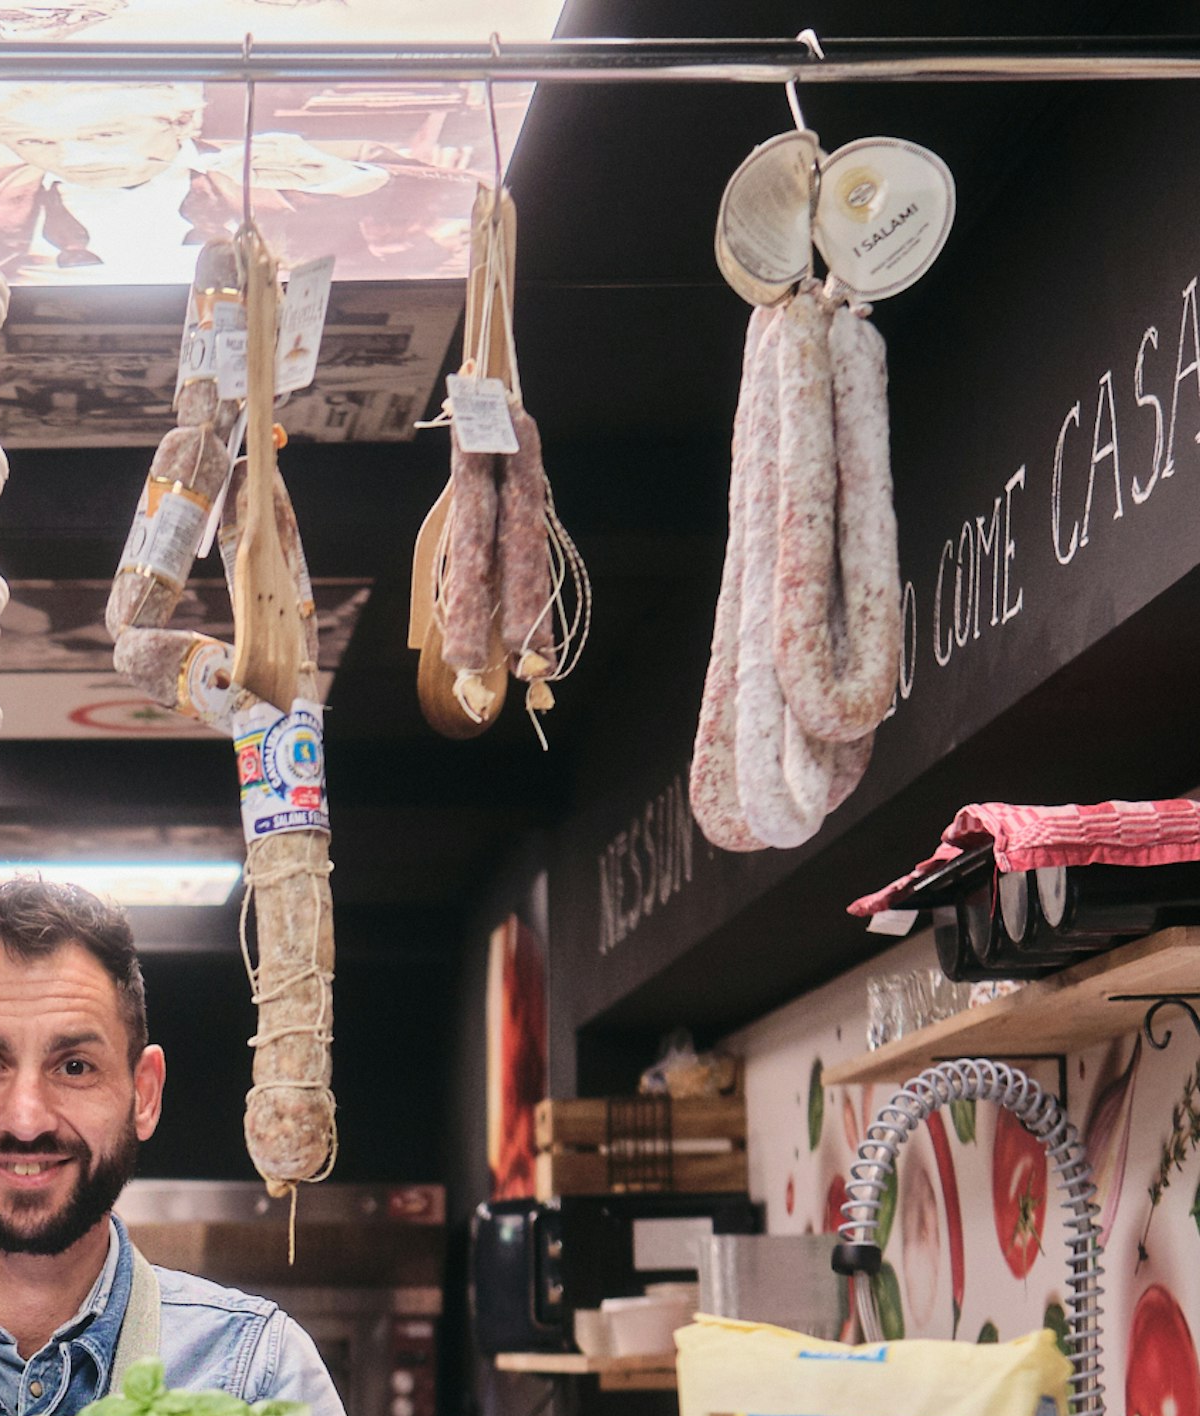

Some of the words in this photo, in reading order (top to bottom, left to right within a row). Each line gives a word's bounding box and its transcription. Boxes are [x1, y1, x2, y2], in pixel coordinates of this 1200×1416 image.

[863, 202, 919, 252] SALAMI
[933, 464, 1026, 667] COME
[1051, 275, 1200, 566] CASA
[273, 811, 308, 829] SALAME
